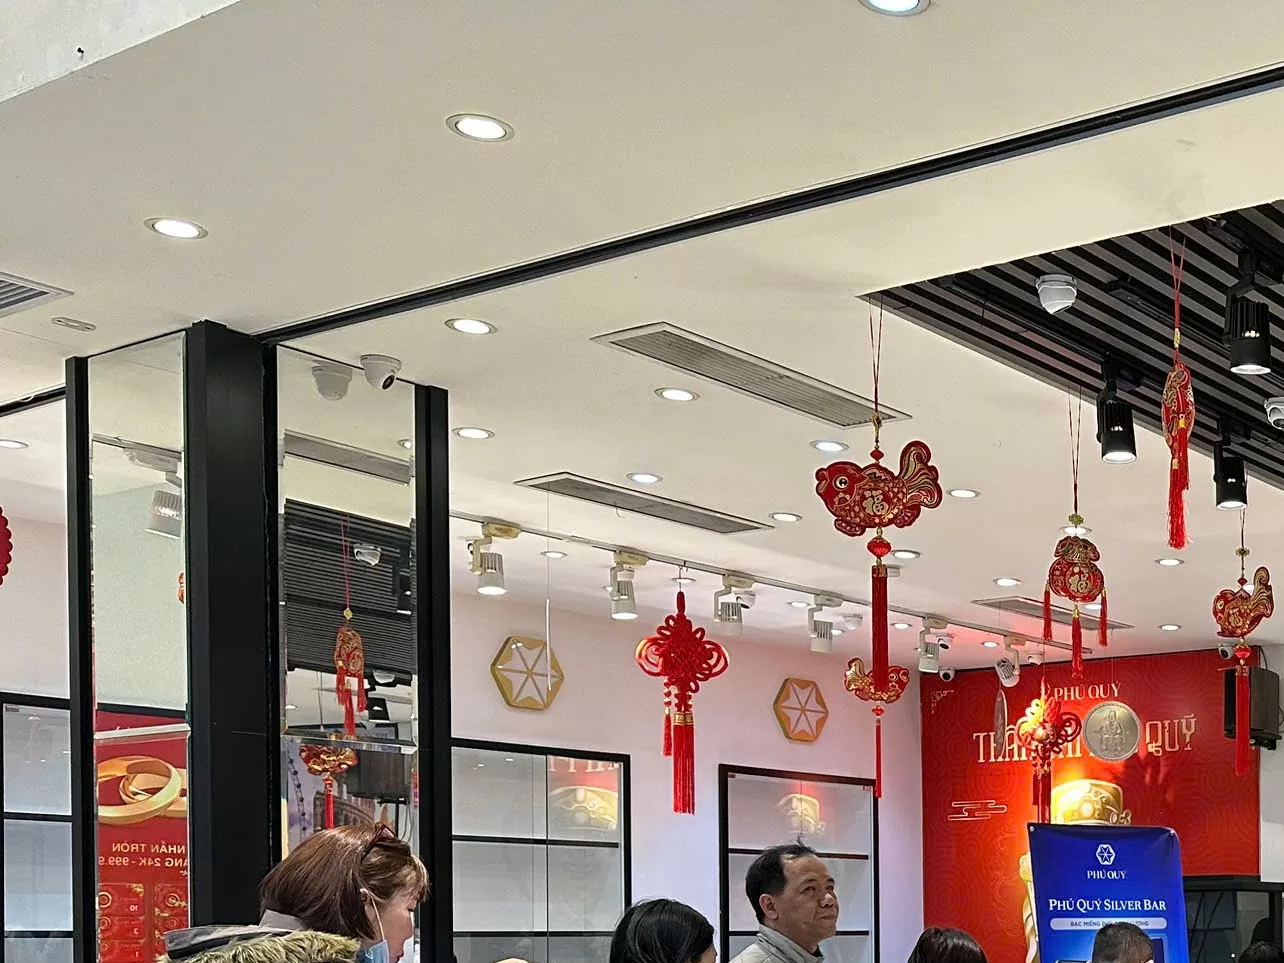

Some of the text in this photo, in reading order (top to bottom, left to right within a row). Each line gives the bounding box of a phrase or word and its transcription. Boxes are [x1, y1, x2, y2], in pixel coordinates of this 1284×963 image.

[1054, 681, 1121, 701] PHÚ QUÝ
[1087, 869, 1106, 880] PHÚ
[1049, 898, 1167, 913] PHÚ QUÝ SILVER BAR
